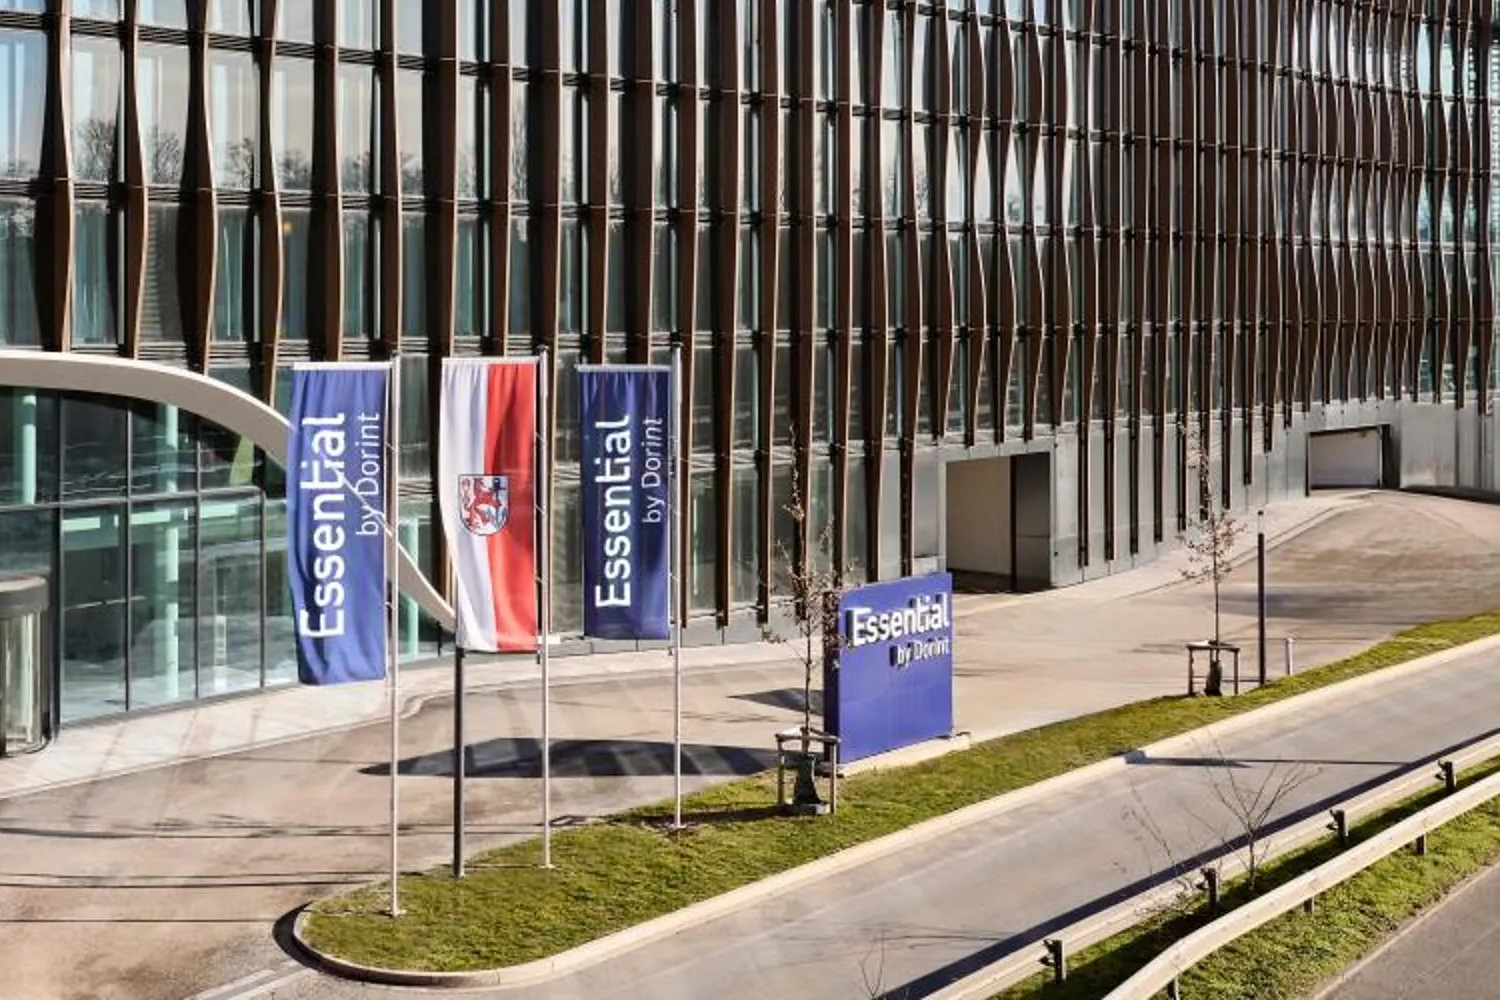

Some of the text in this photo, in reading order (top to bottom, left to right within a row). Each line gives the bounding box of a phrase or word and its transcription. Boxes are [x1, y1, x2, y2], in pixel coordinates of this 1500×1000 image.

[299, 412, 346, 638] Essential
[355, 412, 385, 536] by Dorint
[594, 415, 632, 608] Essential
[641, 416, 665, 523] by Dorint
[846, 592, 950, 647] Essential
[896, 644, 912, 668] by
